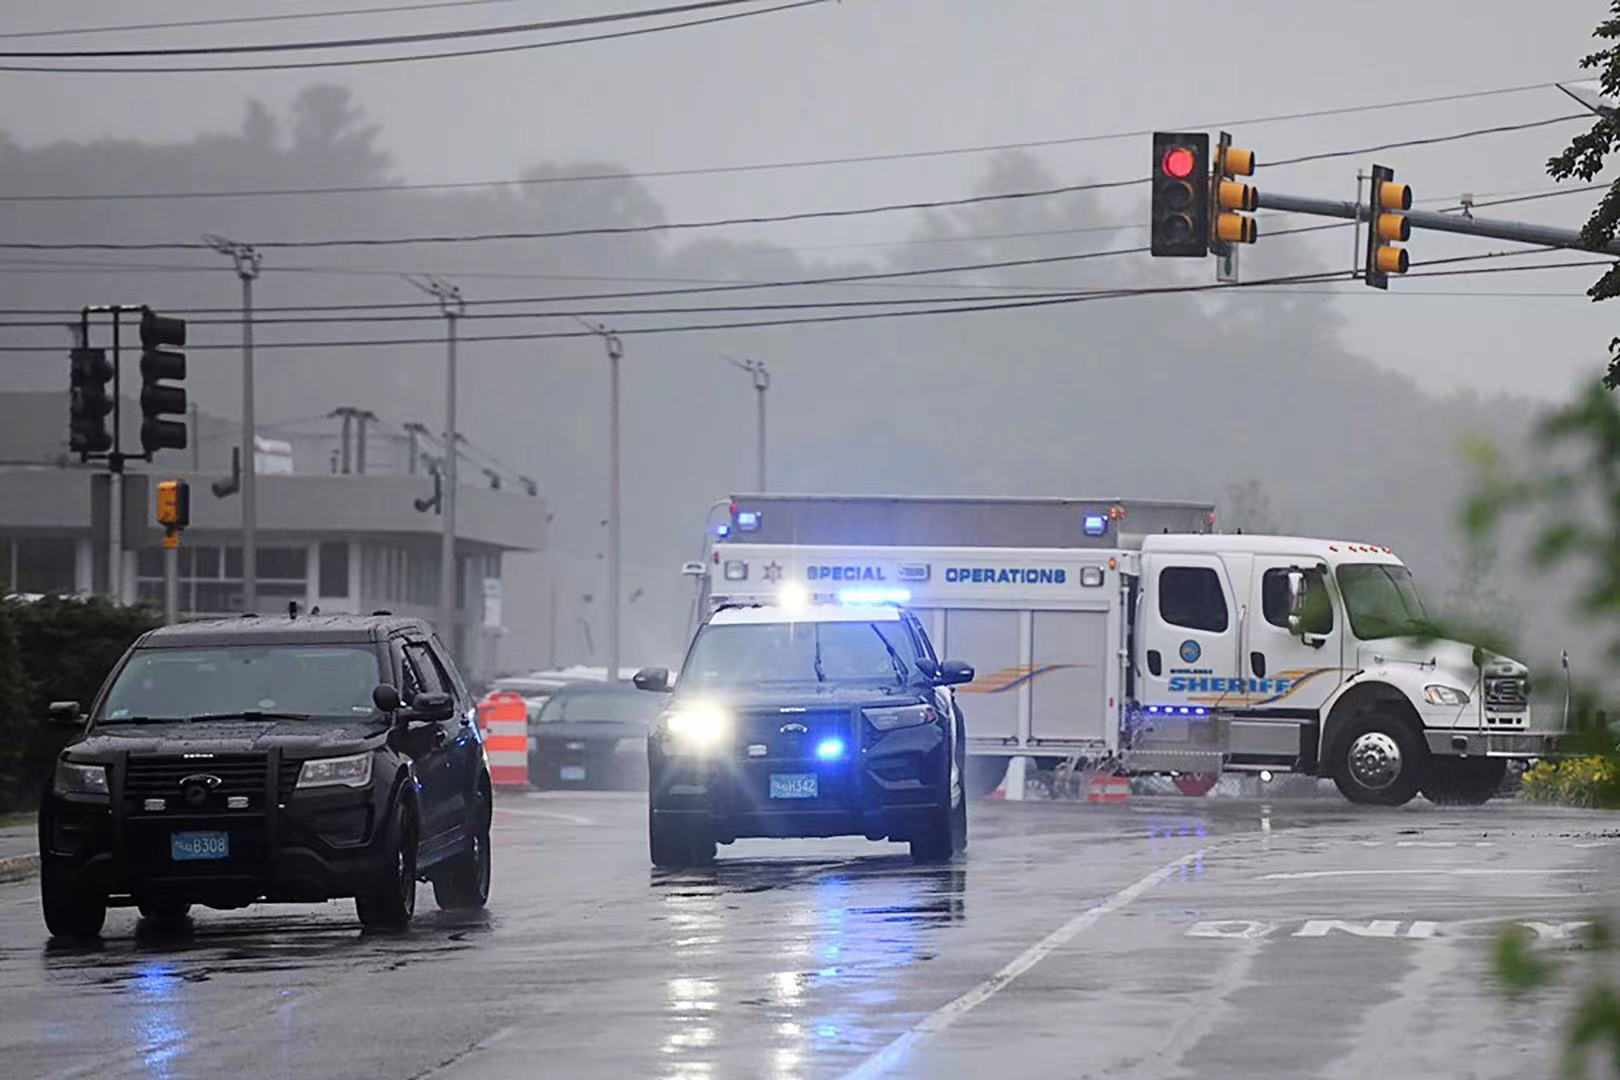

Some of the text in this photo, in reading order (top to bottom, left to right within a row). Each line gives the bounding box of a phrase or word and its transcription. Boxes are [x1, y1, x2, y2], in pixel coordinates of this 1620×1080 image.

[806, 565, 1067, 584] SPECIAL OPERATIONS
[1168, 676, 1292, 693] SHERIFF
